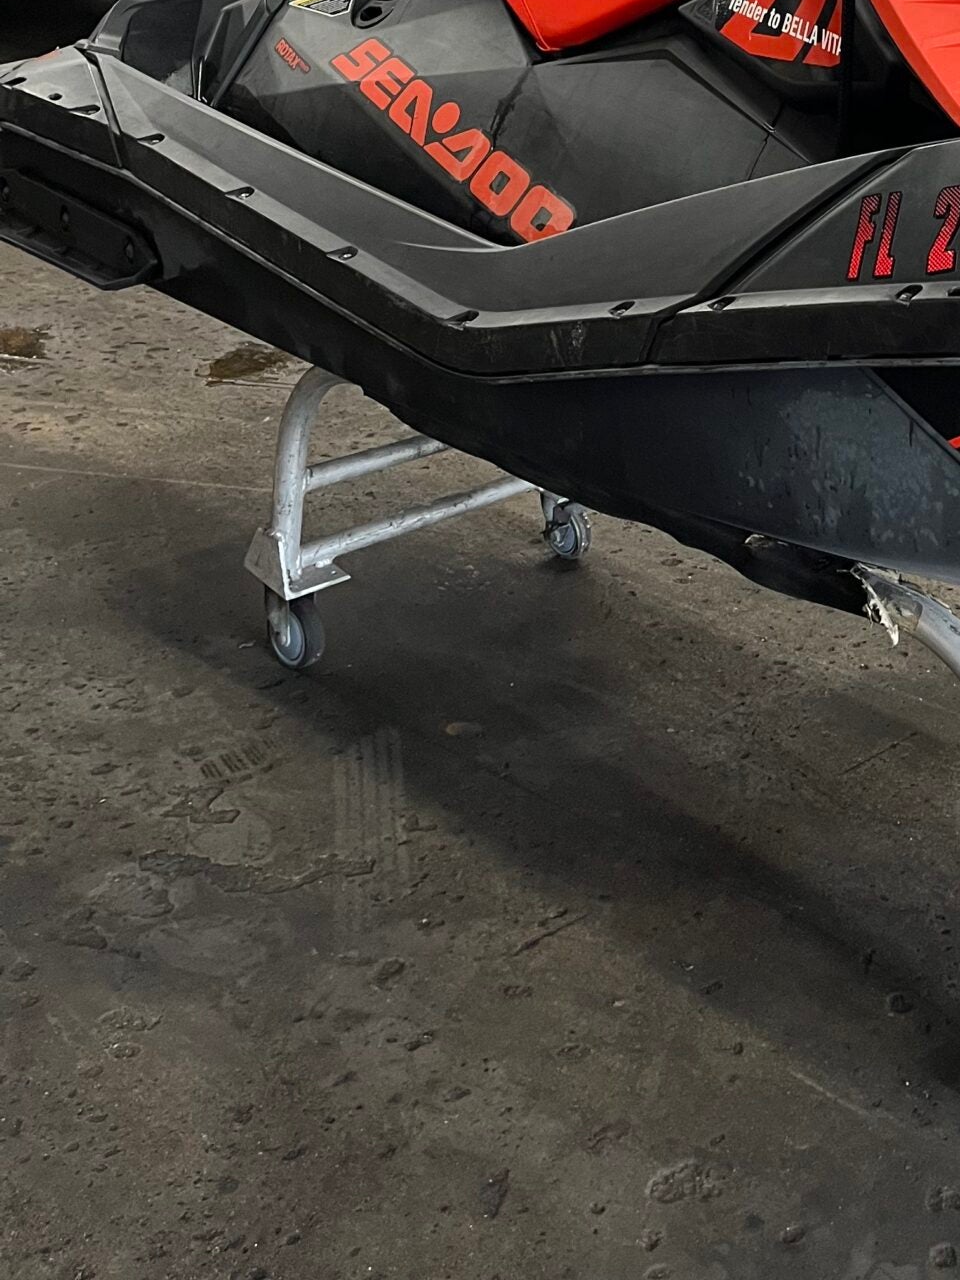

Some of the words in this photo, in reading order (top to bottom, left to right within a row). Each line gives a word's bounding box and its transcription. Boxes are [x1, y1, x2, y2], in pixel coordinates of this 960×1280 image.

[767, 8, 781, 30] to
[781, 13, 818, 46] BELLA
[846, 191, 903, 281] FL
